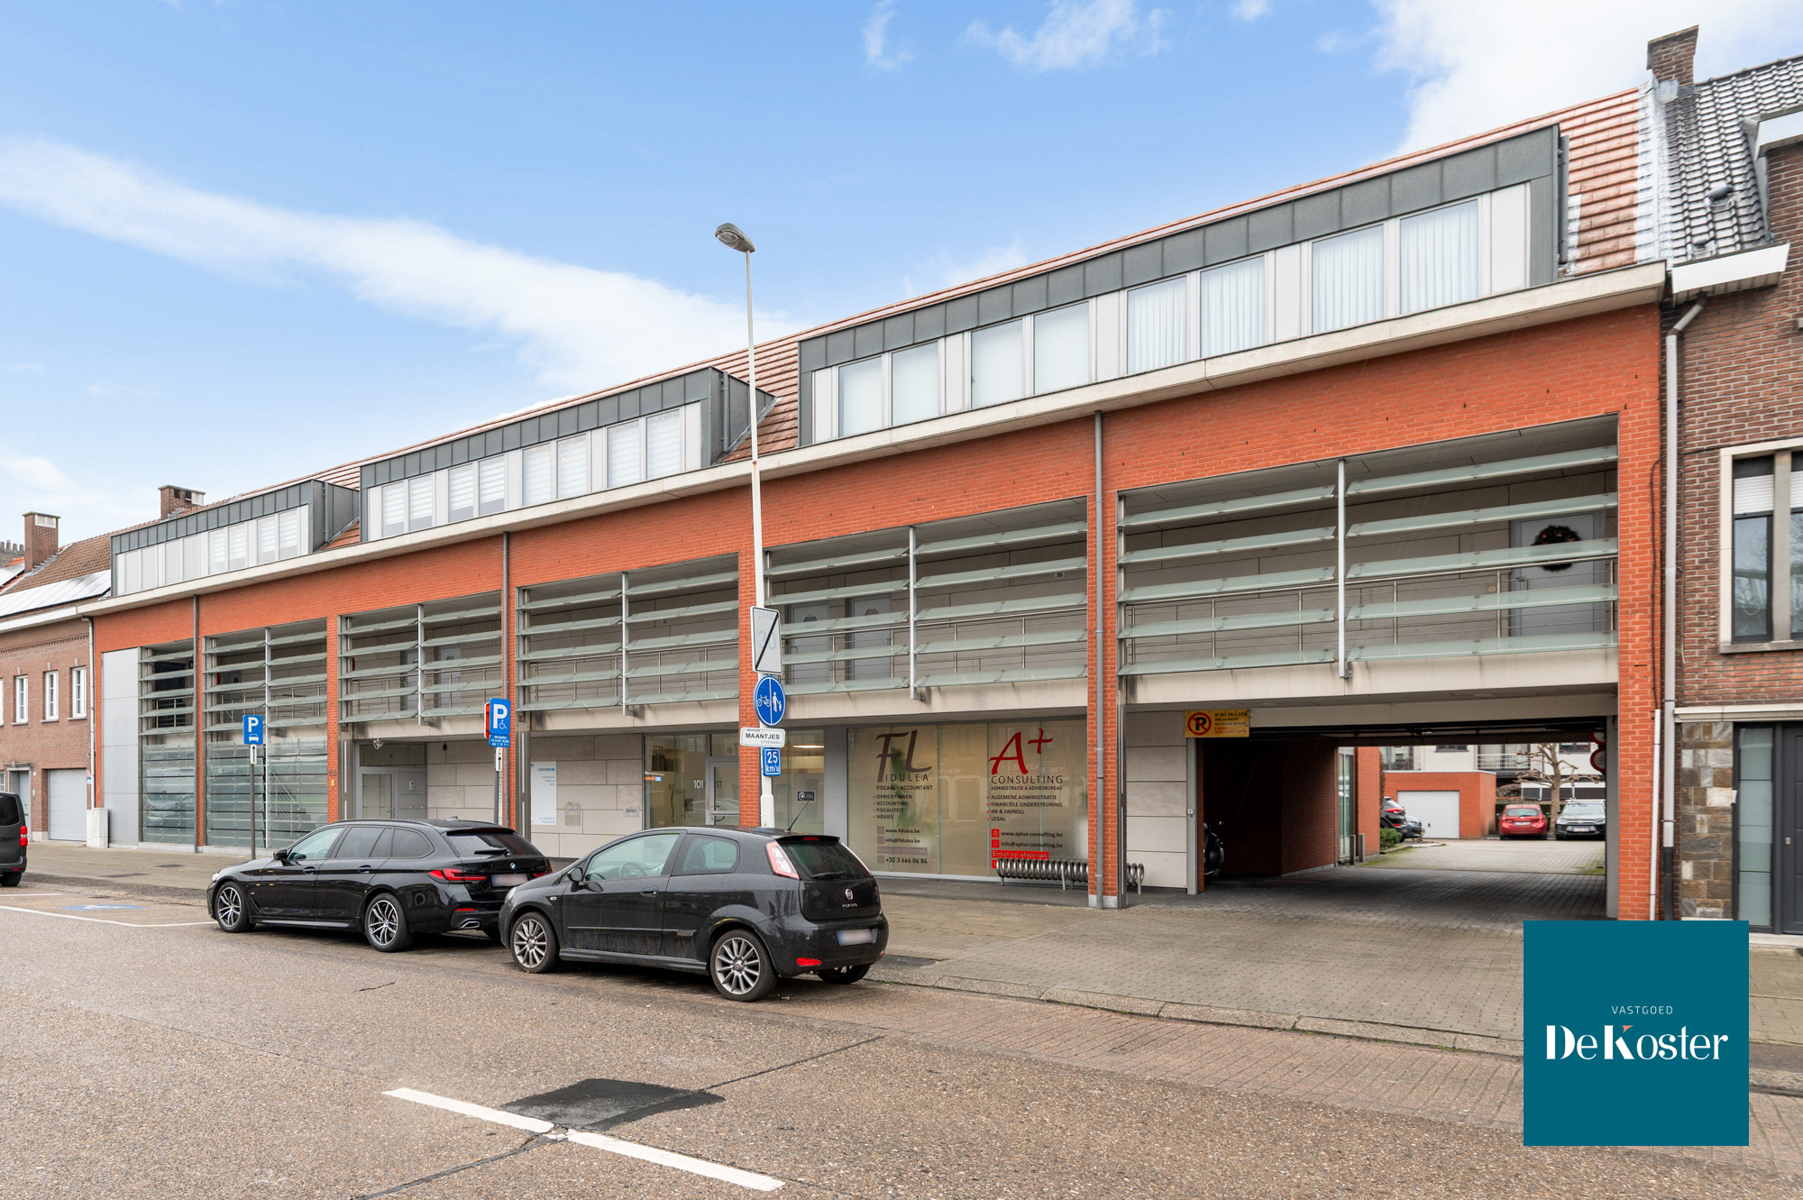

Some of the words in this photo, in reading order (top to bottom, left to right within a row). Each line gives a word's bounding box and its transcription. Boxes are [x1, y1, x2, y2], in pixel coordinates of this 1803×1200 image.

[758, 629, 777, 651] 30
[493, 703, 508, 729] P
[248, 716, 259, 732] P
[745, 732, 780, 740] MAANTJES
[766, 751, 778, 764] 25
[766, 764, 780, 773] km/u
[693, 779, 704, 789] 101
[991, 774, 1064, 785] CONSULTING
[1001, 841, 1064, 849] info@aplus-consulting.be
[1020, 851, 1048, 859] afspraak
